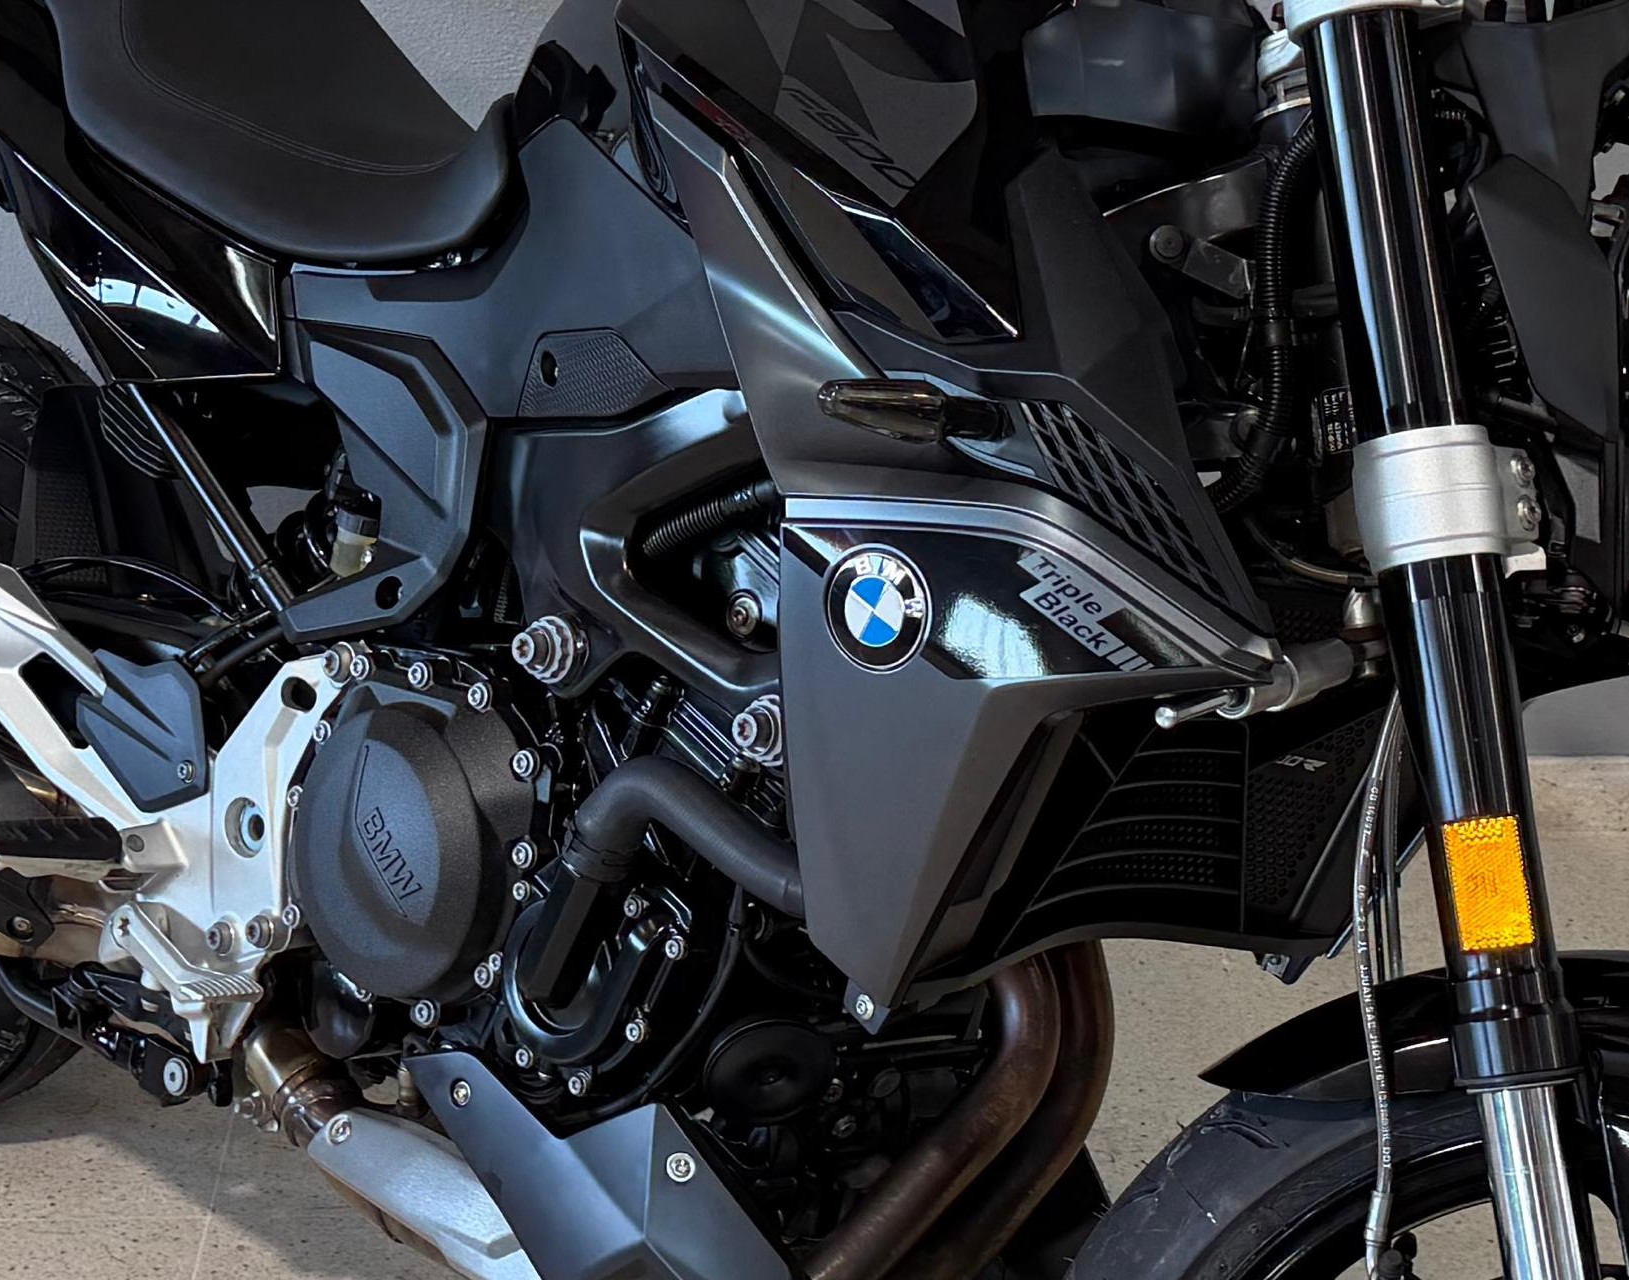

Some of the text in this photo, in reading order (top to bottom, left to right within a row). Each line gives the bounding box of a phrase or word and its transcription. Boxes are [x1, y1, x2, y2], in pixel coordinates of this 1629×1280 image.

[781, 87, 918, 191] F900
[854, 554, 924, 619] BMW
[1032, 555, 1103, 616] Triple
[1033, 591, 1109, 650] Black
[363, 806, 423, 900] BMW
[1381, 1146, 1391, 1169] DOT
